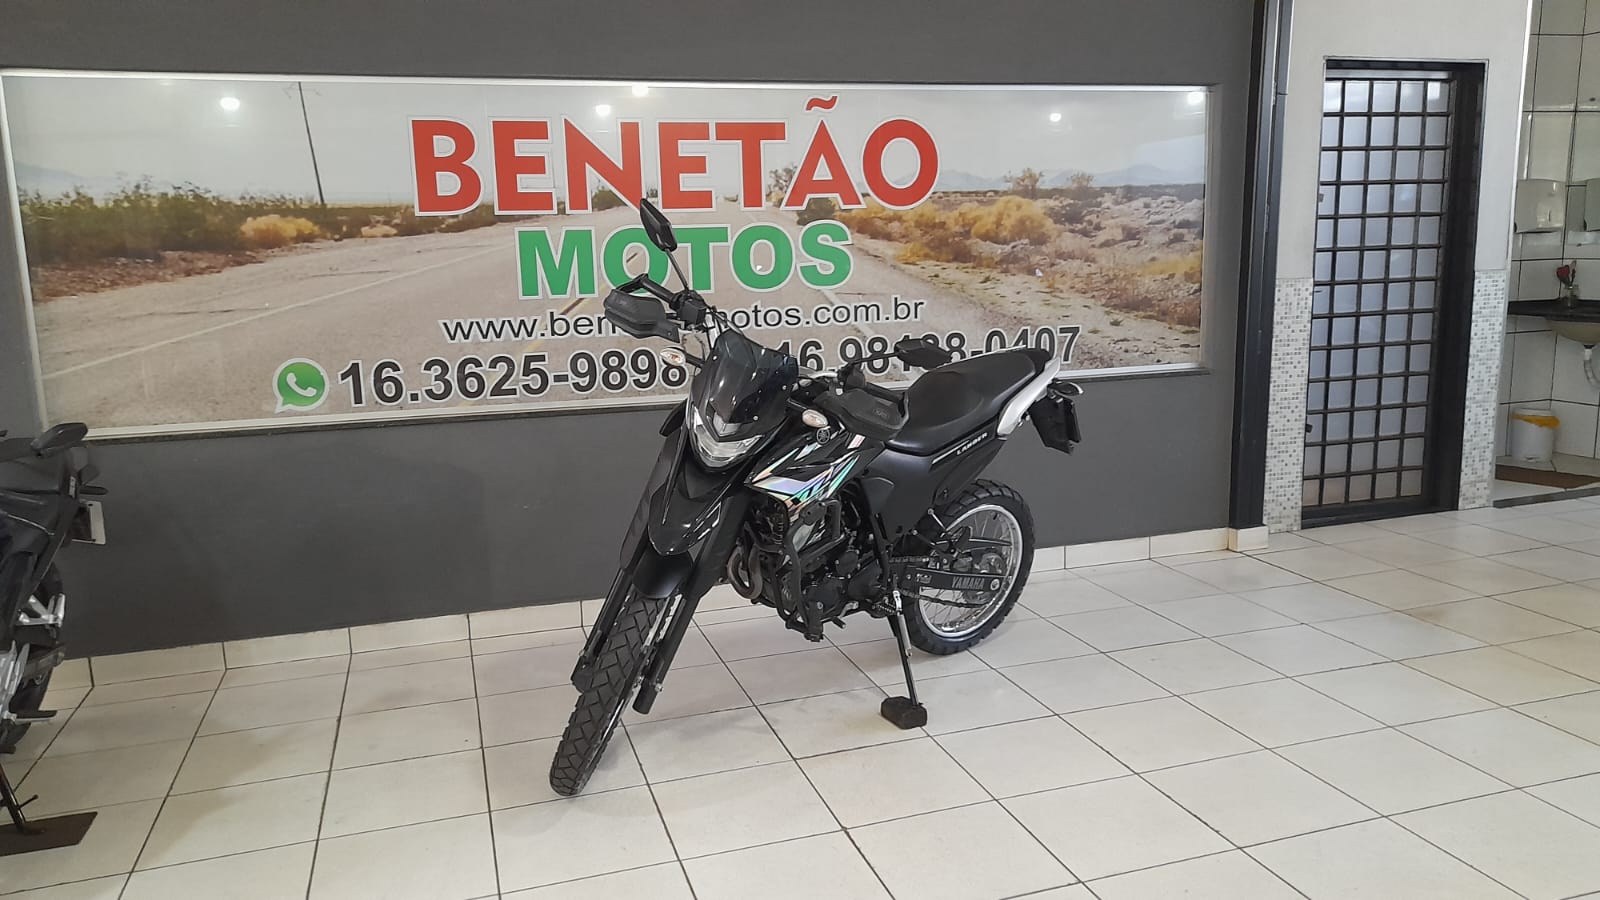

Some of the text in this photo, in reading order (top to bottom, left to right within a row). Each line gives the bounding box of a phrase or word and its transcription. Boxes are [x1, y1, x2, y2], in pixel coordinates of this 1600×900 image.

[410, 95, 939, 214] BENETÃO
[518, 220, 852, 297] MOTOS
[442, 298, 924, 343] www.benotos.com.br
[778, 325, 1080, 374] 6.988-007
[339, 349, 687, 405] 16.3625-9898
[951, 576, 985, 590] YAMAHA
